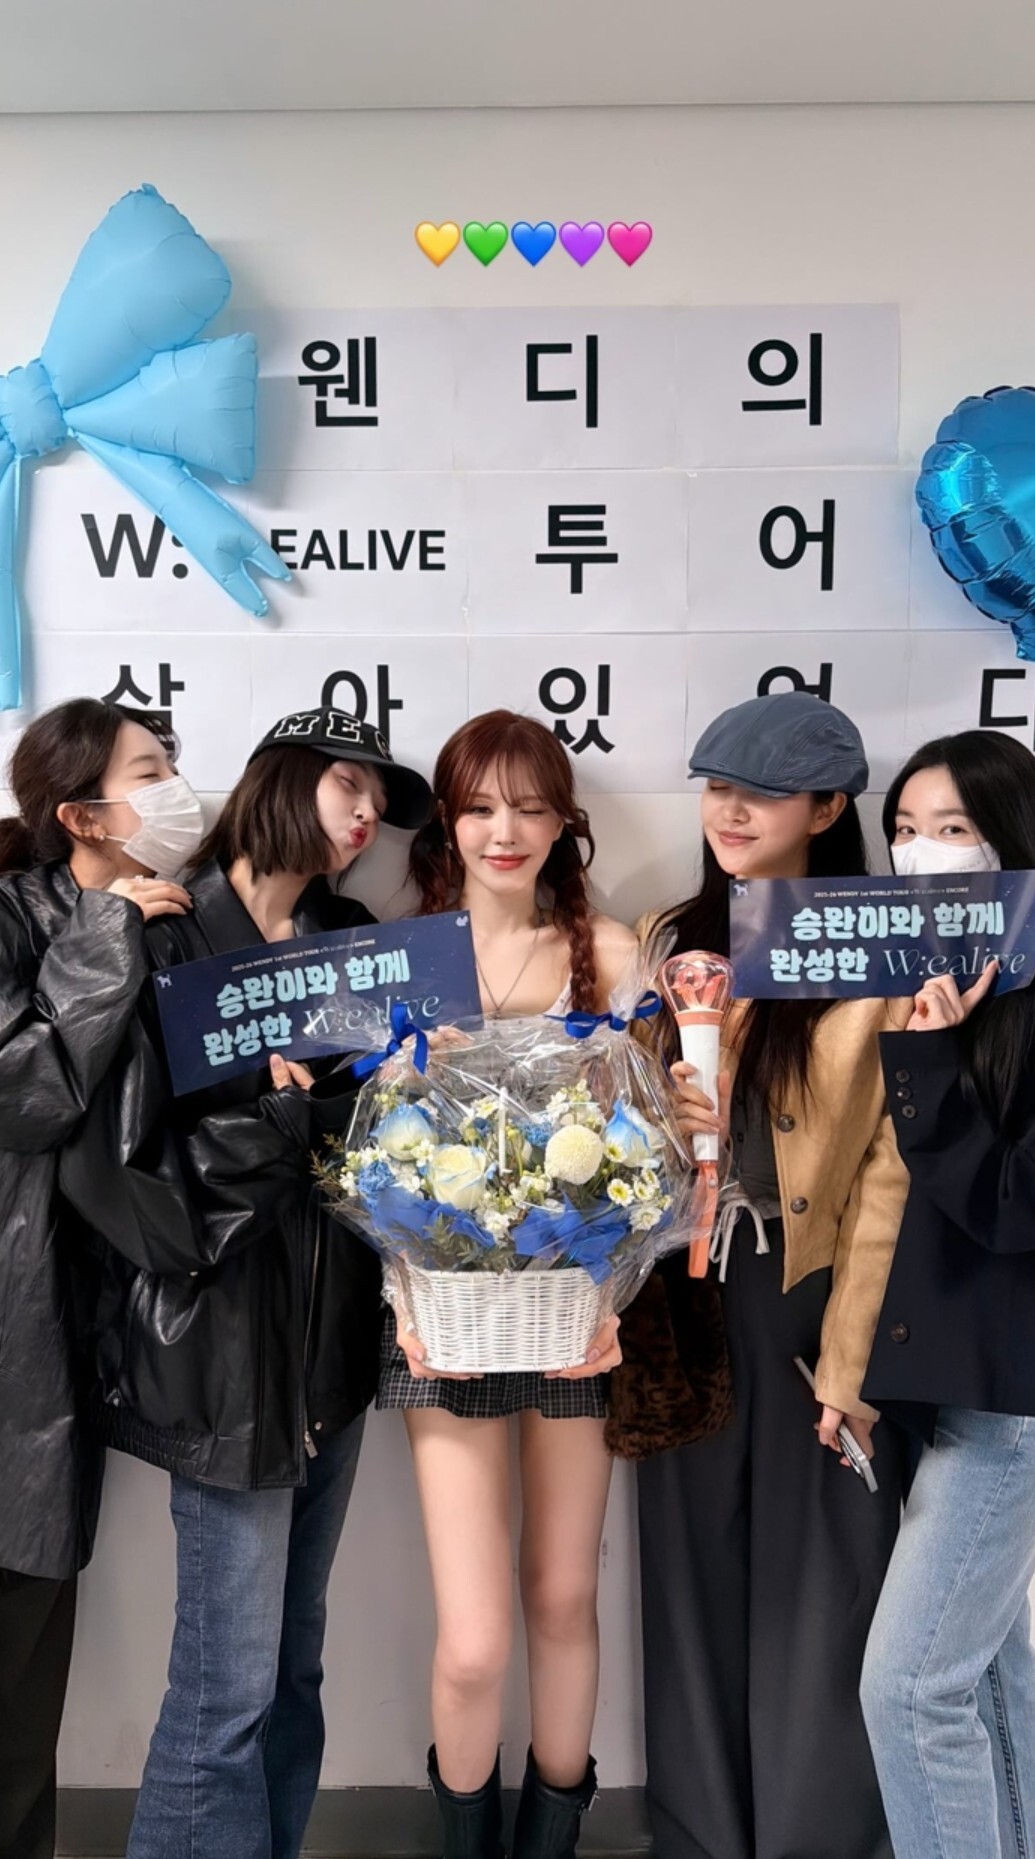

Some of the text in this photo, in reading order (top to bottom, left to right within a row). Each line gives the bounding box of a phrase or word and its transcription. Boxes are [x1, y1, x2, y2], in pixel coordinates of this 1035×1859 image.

[270, 529, 446, 571] EALIVE
[791, 901, 1005, 941] 승완이와 함께
[216, 948, 411, 1019] 승완이와 함께
[769, 947, 870, 982] 완성한
[202, 995, 440, 1068] 완성한 W:ealve
